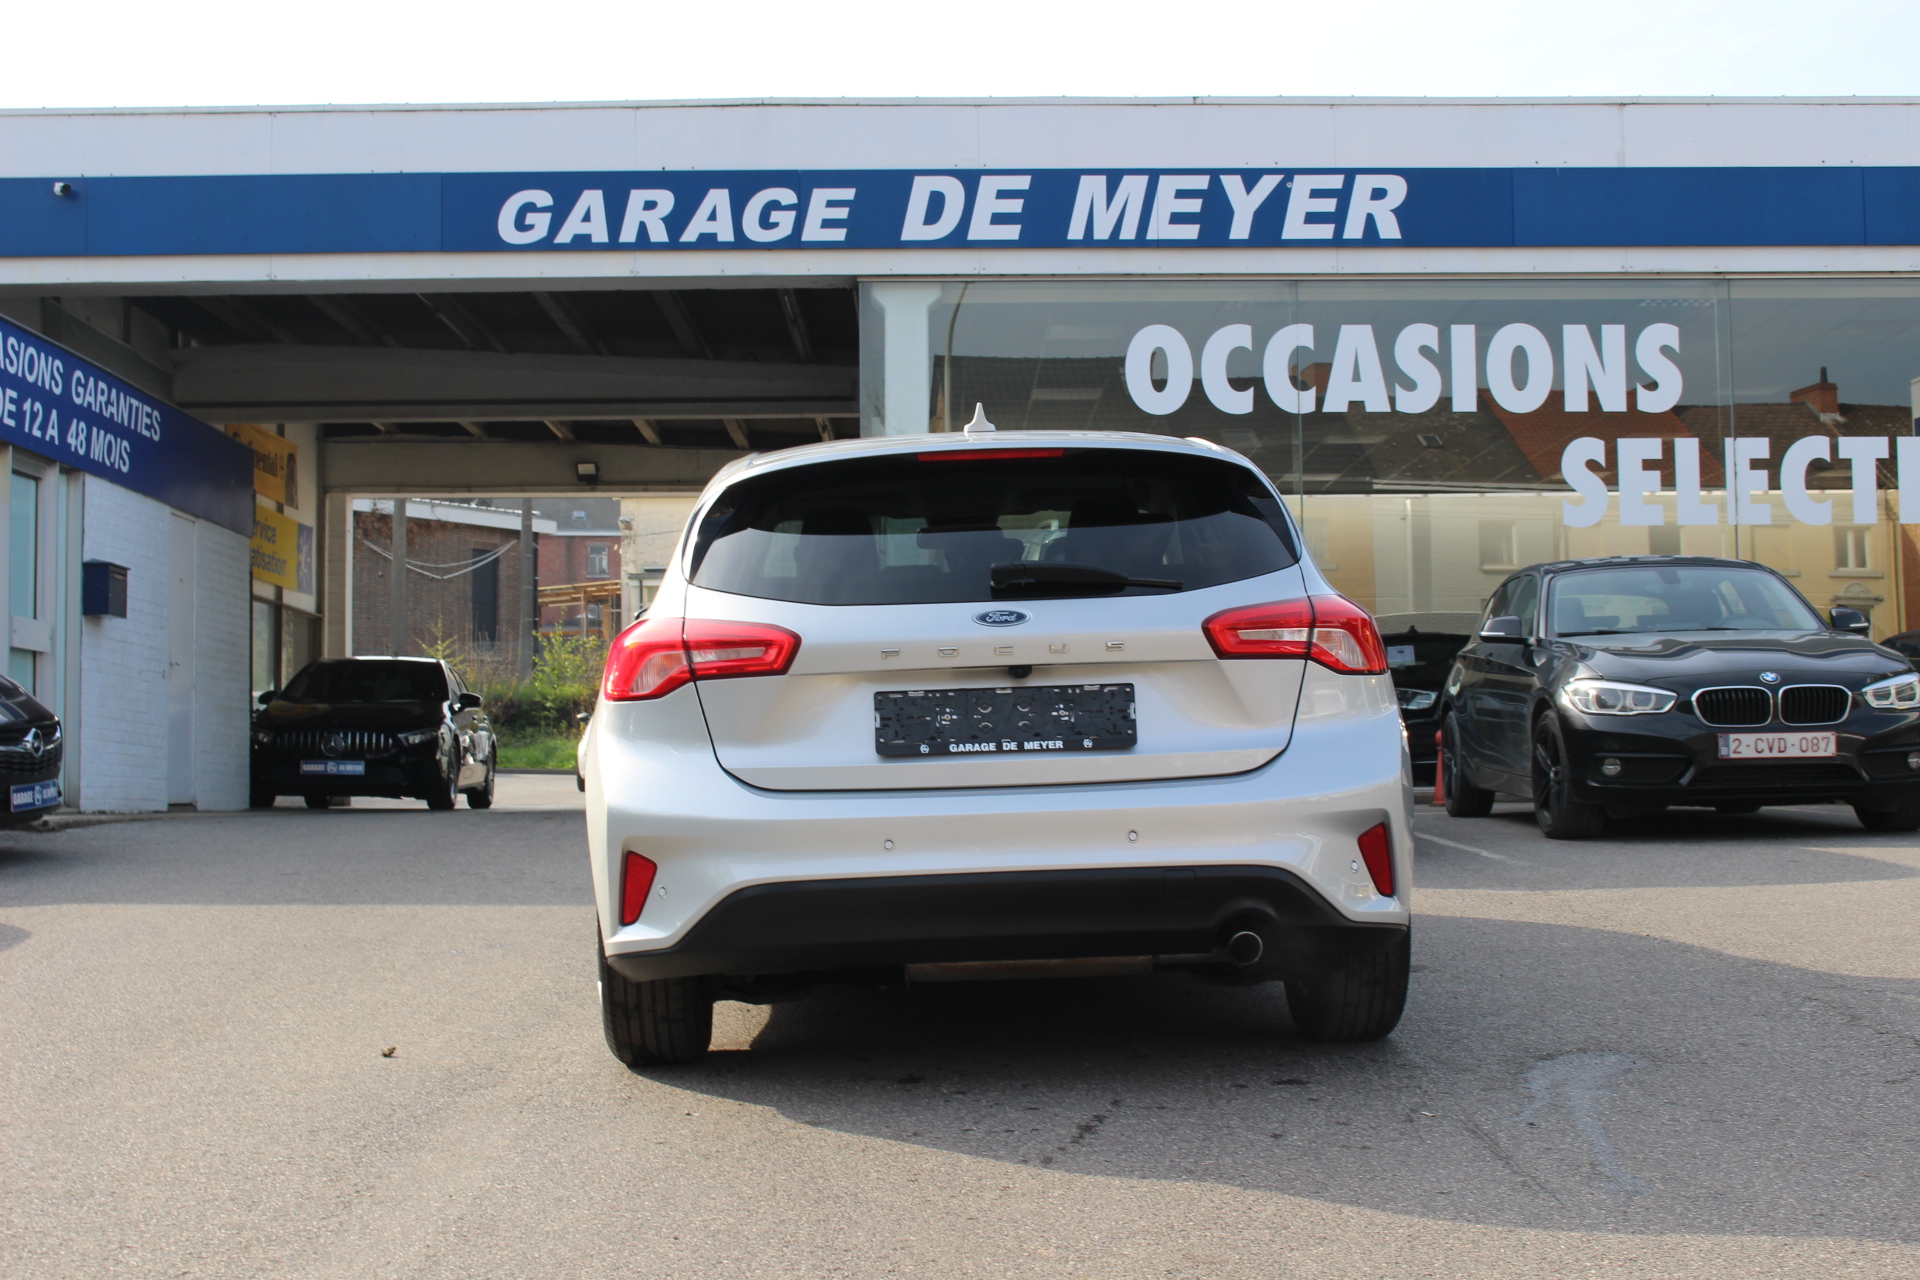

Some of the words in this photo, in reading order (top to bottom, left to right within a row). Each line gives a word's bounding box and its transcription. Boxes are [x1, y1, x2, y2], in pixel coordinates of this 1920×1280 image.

[497, 187, 857, 245] GARAGE
[900, 174, 1032, 241] DE
[1066, 173, 1408, 240] MEYER
[1124, 322, 1684, 415] OCCASIONS
[72, 369, 161, 442] GARANTIES
[23, 397, 43, 438] 12
[45, 408, 59, 445] A
[67, 418, 87, 456] 48
[90, 426, 131, 473] MOIS
[985, 611, 1018, 622] Ford
[881, 640, 1125, 660] FOCUS
[949, 742, 997, 752] GARAGE
[1002, 741, 1018, 750] DE
[1023, 740, 1064, 750] MEYER
[1731, 736, 1831, 755] 2-CVD-087
